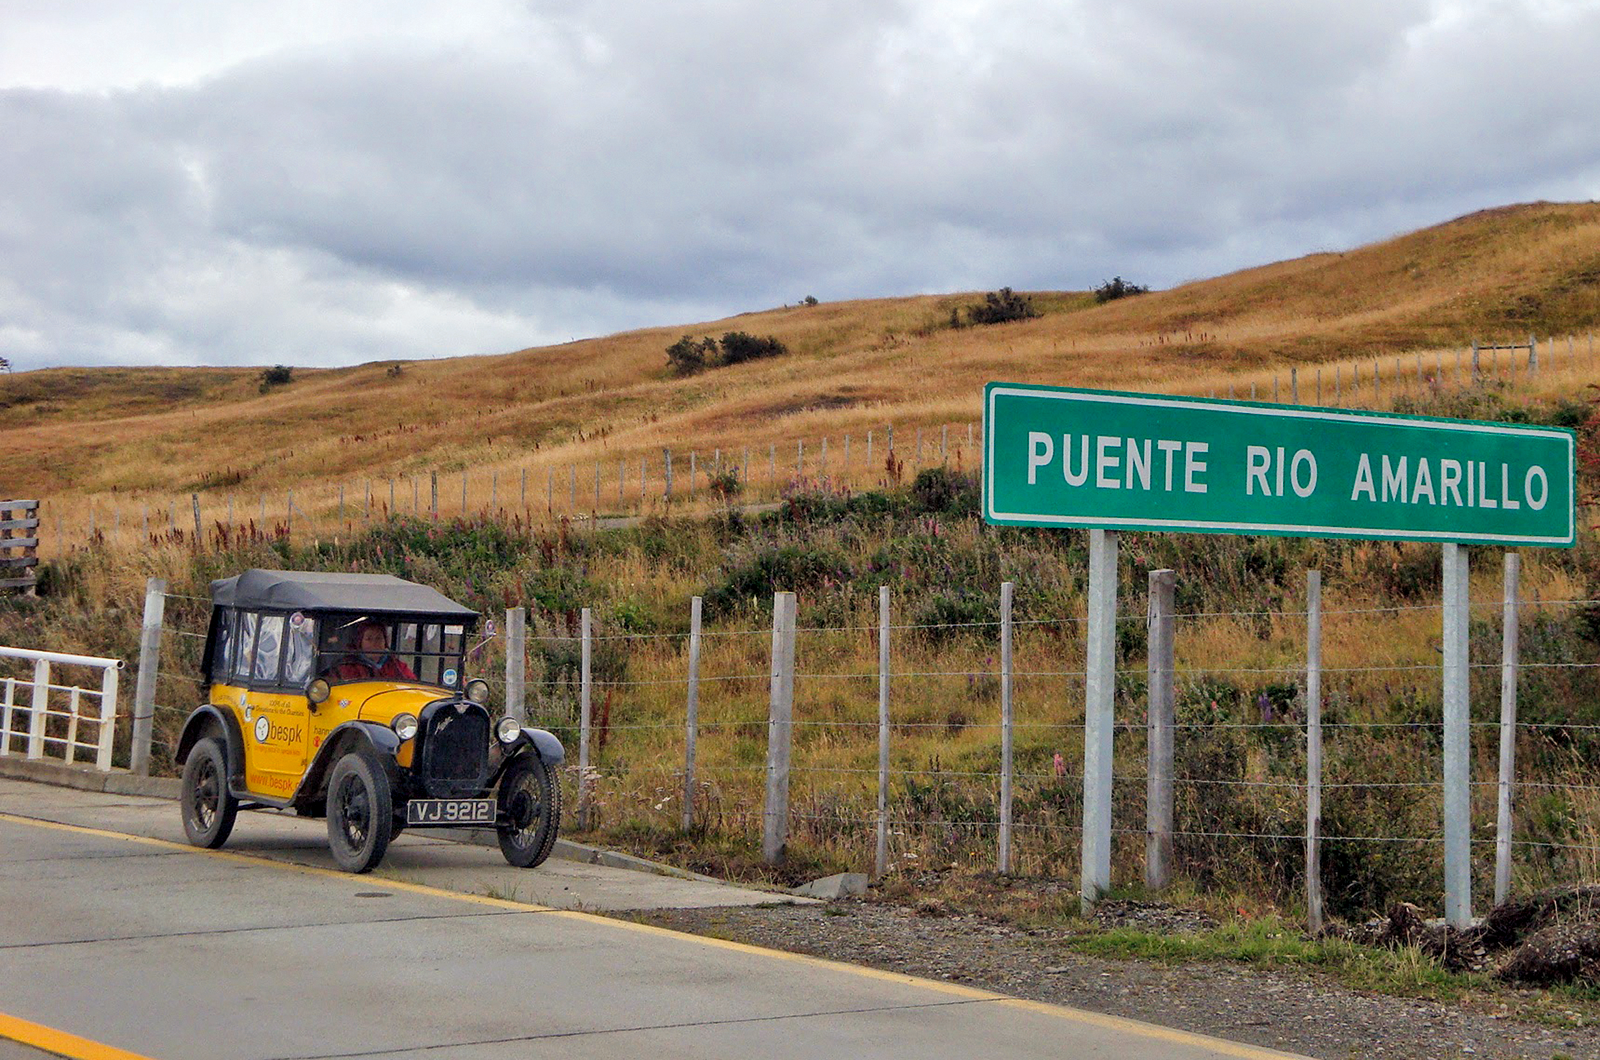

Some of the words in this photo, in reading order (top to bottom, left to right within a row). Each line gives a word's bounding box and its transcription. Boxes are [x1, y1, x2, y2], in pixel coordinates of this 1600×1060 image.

[1028, 432, 1208, 492] PUENTE
[1247, 446, 1317, 497] RIO
[1352, 454, 1548, 510] AMARILLO
[270, 721, 302, 746] bespk
[416, 802, 441, 821] VJ
[446, 802, 489, 820] 9212
